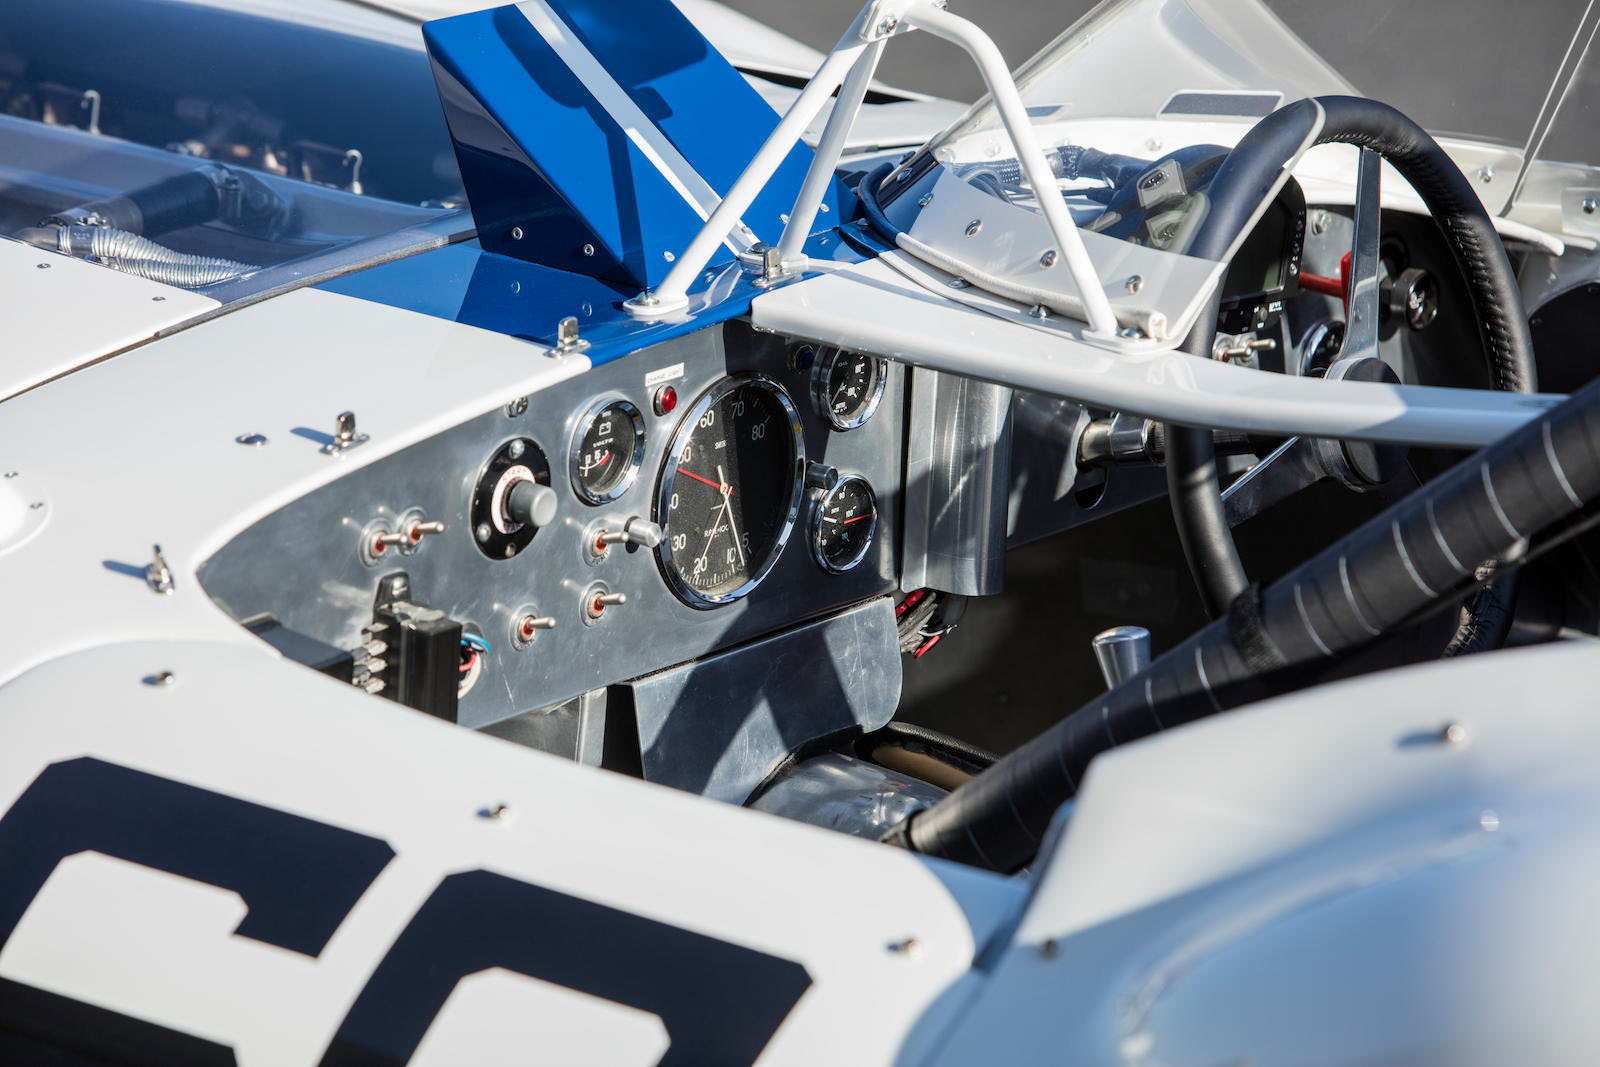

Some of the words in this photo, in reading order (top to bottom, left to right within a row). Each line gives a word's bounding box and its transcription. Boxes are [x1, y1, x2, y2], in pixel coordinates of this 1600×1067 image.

[731, 400, 745, 420] 70
[699, 410, 715, 429] 60
[751, 423, 765, 441] 80
[671, 533, 687, 551] 30
[693, 556, 708, 574] 20
[726, 547, 738, 565] 10
